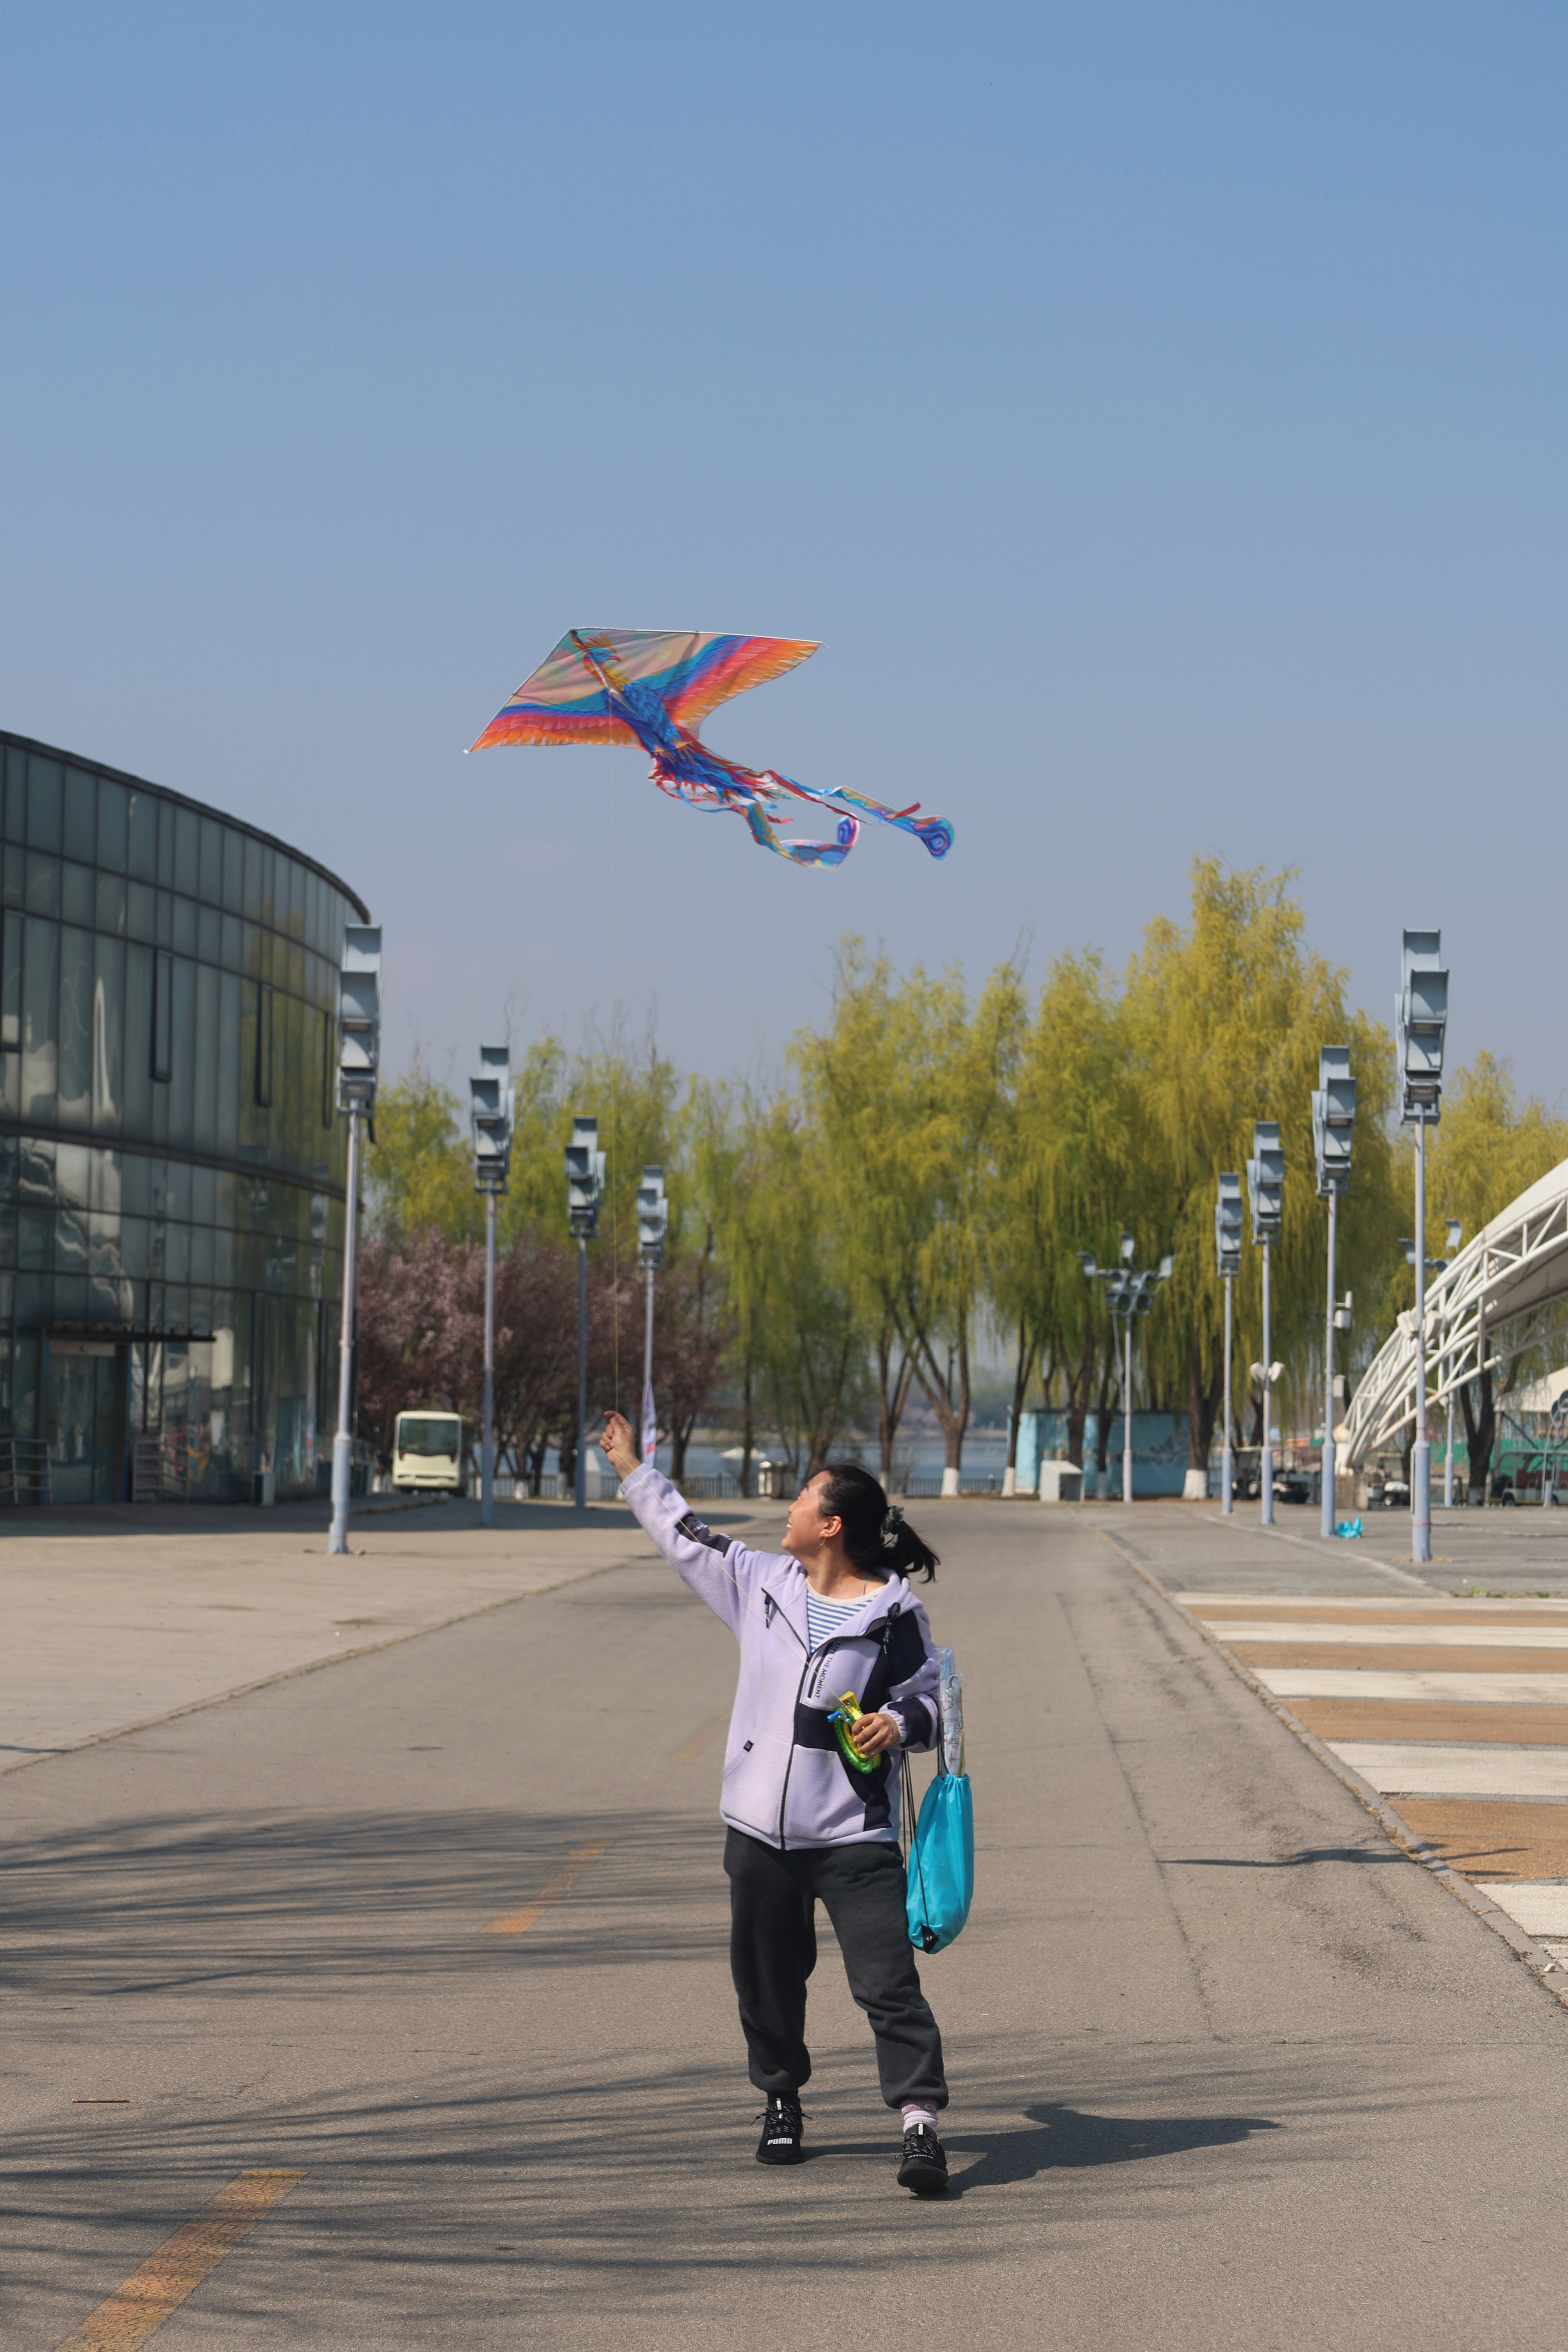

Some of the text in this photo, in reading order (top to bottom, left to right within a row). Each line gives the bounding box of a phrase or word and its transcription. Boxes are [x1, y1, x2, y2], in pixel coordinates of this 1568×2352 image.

[815, 1642, 840, 1699] LIVE THE MOMENT
